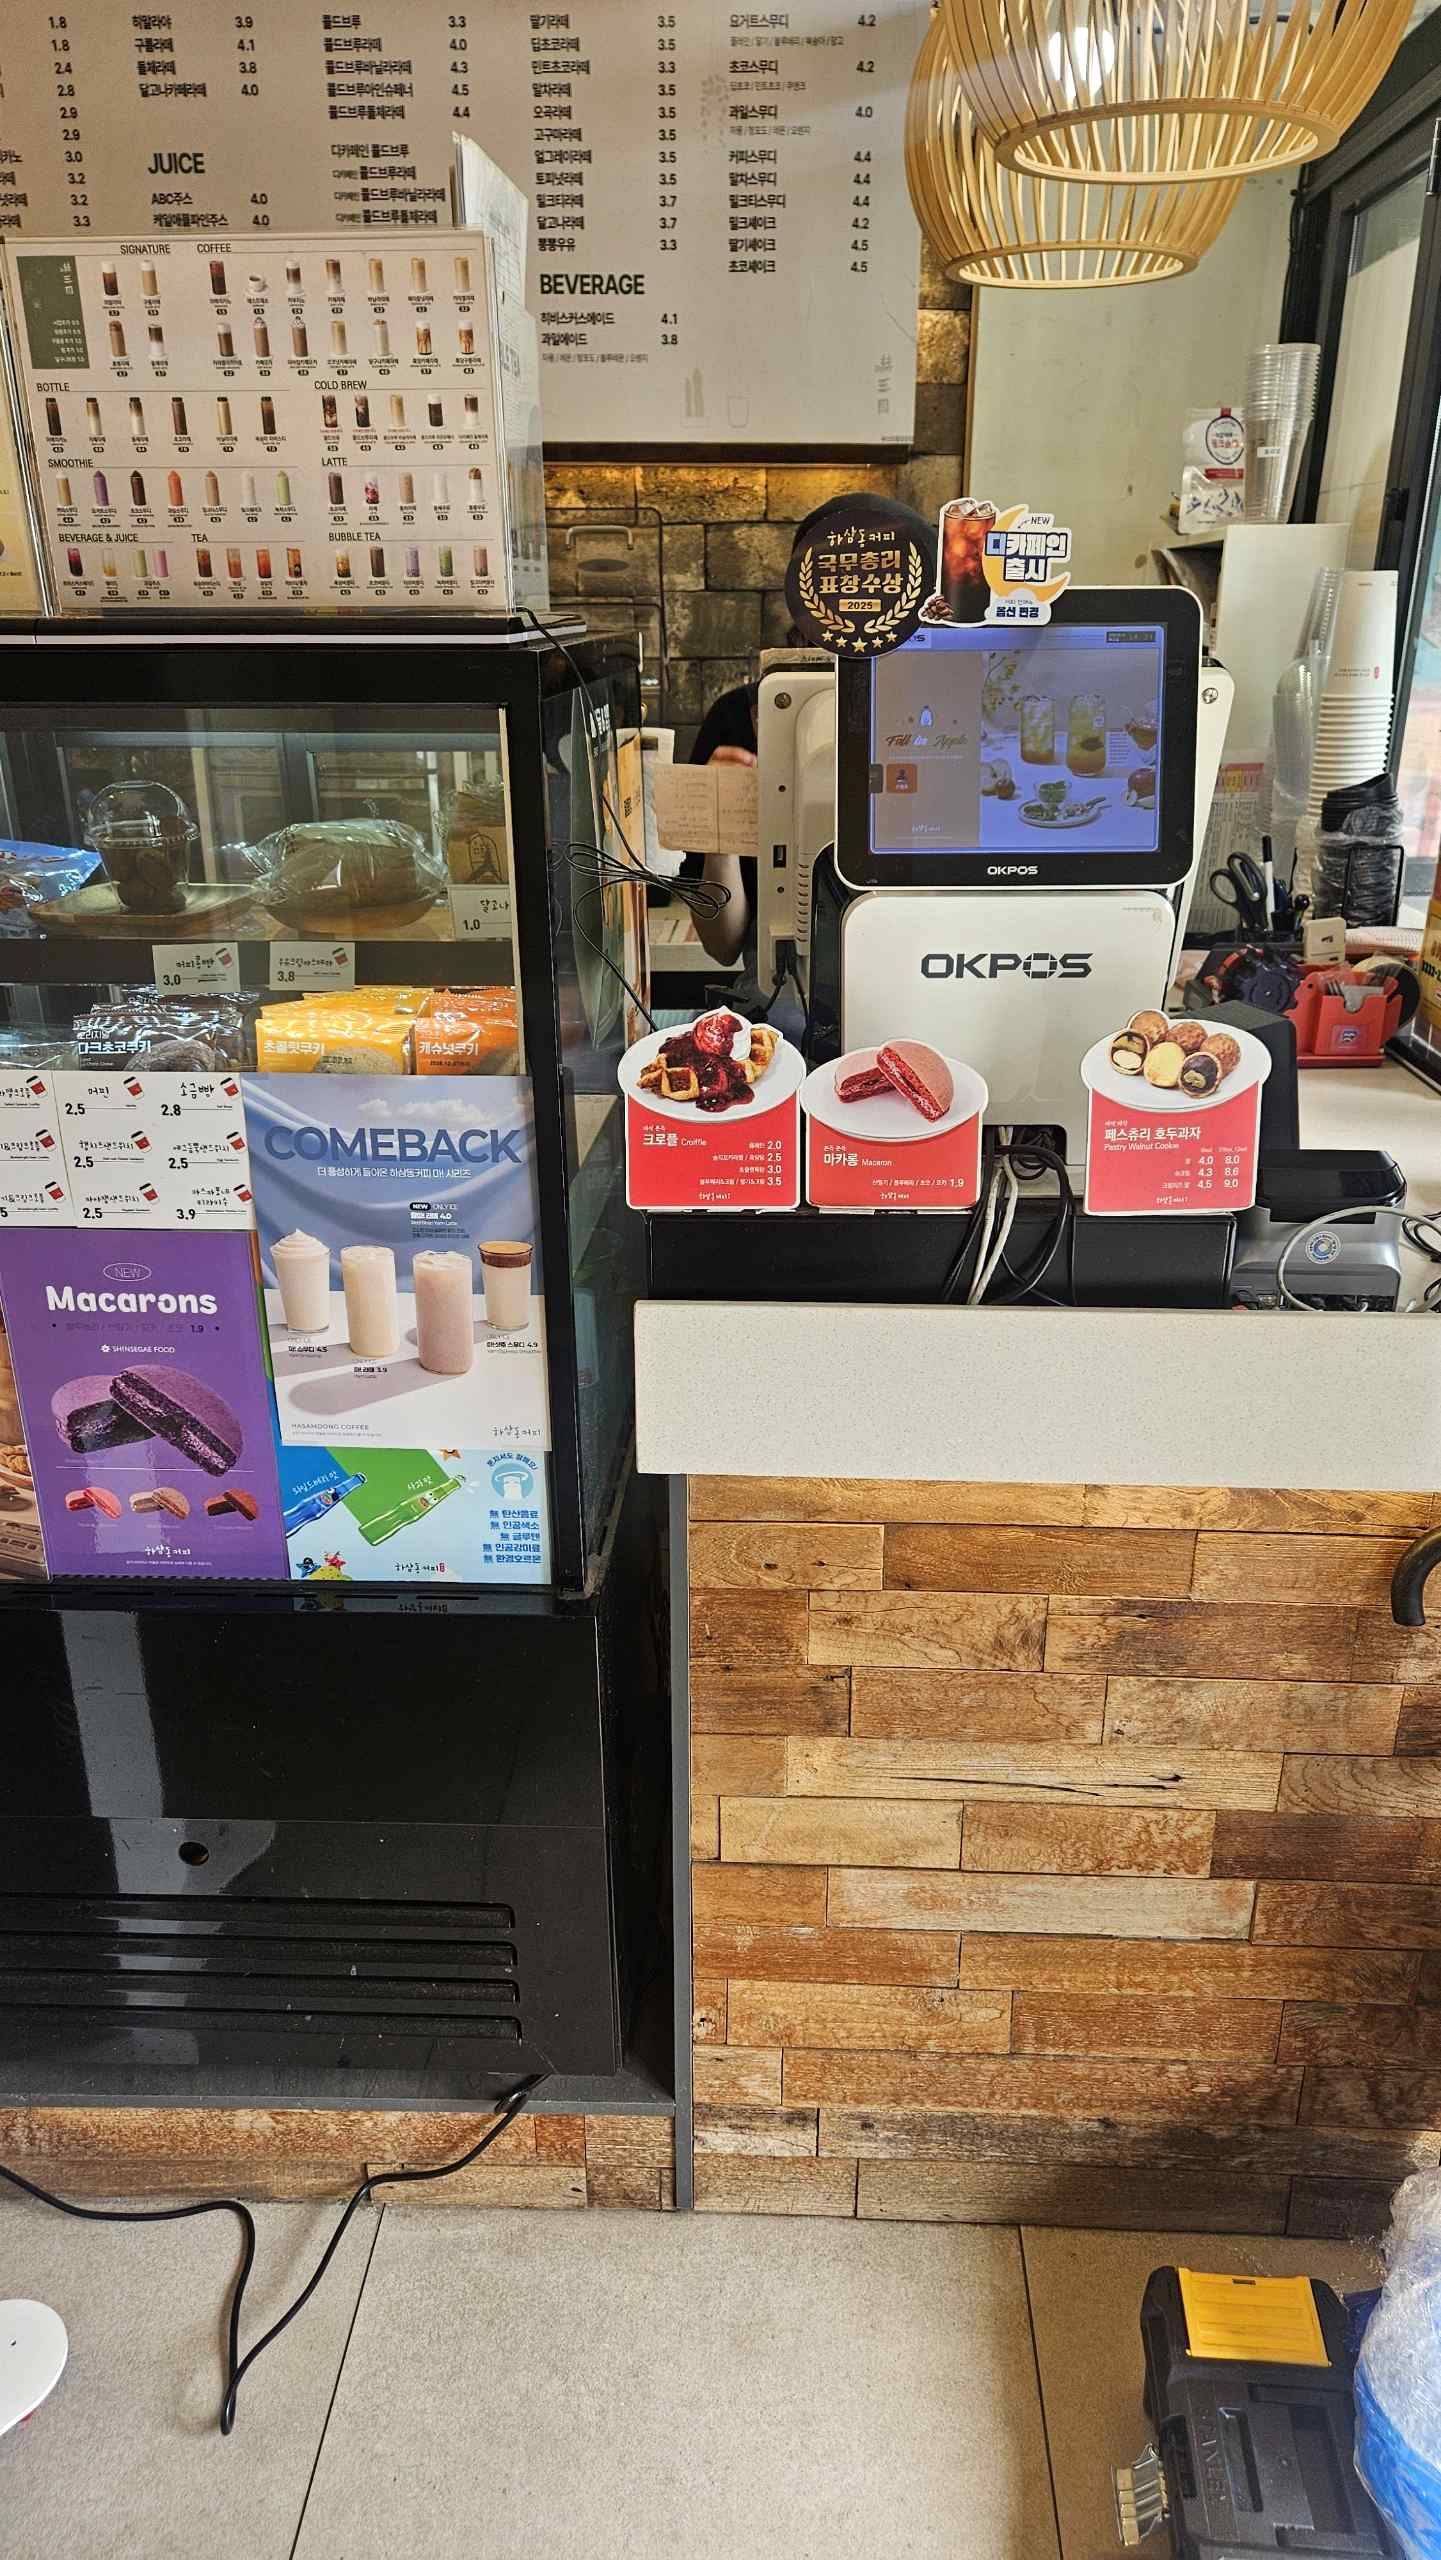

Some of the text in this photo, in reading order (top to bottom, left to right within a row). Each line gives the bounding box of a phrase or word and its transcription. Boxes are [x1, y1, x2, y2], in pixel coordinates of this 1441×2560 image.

[49, 17, 67, 29] 1.8
[235, 16, 253, 29] 3.9
[322, 15, 467, 30] 콜드브루 3.3
[530, 14, 676, 30] 딸기라떼 3.5
[729, 14, 877, 29] 요거트스무디 4.2
[52, 39, 70, 52] 1.8
[237, 39, 255, 52] 4.1
[324, 37, 467, 53] 콜드브루라떼 4.0
[657, 38, 676, 51] 3.5
[55, 62, 72, 74] 2.4
[239, 62, 257, 74] 3.8
[450, 61, 468, 74] 4.3
[532, 60, 676, 75] 민트초코라떼 3.3
[729, 60, 875, 75] 초코스무디 4.2
[58, 85, 75, 97] 2.8
[241, 84, 259, 97] 4.0
[451, 84, 469, 96] 4.5
[658, 84, 676, 96] 3.5
[60, 107, 78, 119] 2.9
[452, 107, 470, 119] 4.4
[658, 107, 676, 119] 3.5
[729, 105, 873, 120] 과일스무디 4.0
[63, 129, 80, 141] 2.9
[534, 128, 677, 142] 고구마라떼 3.5
[372, 143, 409, 158] 콜드브루
[65, 151, 82, 163] 3.0
[659, 151, 677, 164] 3.5
[728, 150, 872, 165] 커피스무디 4.4
[148, 152, 205, 175] JUICE
[68, 172, 85, 185] 3.2
[659, 173, 677, 185] 3.5
[852, 173, 871, 185] 4.4
[71, 194, 88, 206] 3.2
[152, 193, 268, 206] ABC주스 4.0
[659, 195, 677, 207] 3.7
[852, 195, 870, 207] 4.4
[73, 215, 90, 227] 3.3
[252, 215, 270, 227] 4.0
[659, 218, 677, 230] 3.7
[851, 217, 870, 230] 4.2
[120, 244, 171, 256] SIGNATURE
[197, 243, 232, 254] COFFEE
[659, 239, 677, 251] 3.3
[850, 239, 869, 252] 4.5
[850, 261, 869, 273] 4.5
[540, 274, 645, 295] BEVERAGE
[661, 313, 678, 325] 4.1
[541, 333, 678, 347] 과일에이드 3.8
[36, 382, 70, 393] BOTTLE
[314, 380, 367, 391] COLD BREW
[48, 458, 94, 469] SMOOTHIE
[321, 457, 348, 467] LATTE
[1031, 516, 1051, 525] NEW
[58, 533, 139, 543] BEVERAGE & JUICE
[192, 533, 209, 543] TEA
[328, 532, 381, 542] BUBBLE TEA
[985, 531, 1068, 557] 디카페인
[817, 550, 903, 572] 국무총리
[1004, 556, 1048, 582] 출시
[819, 573, 904, 595] 표창수상
[847, 601, 873, 610] 2025
[1019, 606, 1040, 618] 변경
[987, 865, 1039, 876] OKPOS
[480, 898, 511, 912] 달고나
[463, 919, 481, 930] 1.0
[920, 952, 1095, 979] OKPOS
[163, 975, 181, 986] 3.0
[277, 971, 295, 982] 3.8
[418, 1041, 479, 1057] 캐슈넛쿠키
[88, 1086, 109, 1099] 머핀
[180, 1082, 215, 1099] 소금빵
[65, 1103, 85, 1116] 2.5
[161, 1104, 181, 1117] 2.8
[1153, 1126, 1201, 1141] 호두과자
[264, 1126, 523, 1165] COMEBACK
[643, 1133, 679, 1147] 크로플
[767, 1140, 782, 1150] 2.0
[1103, 1141, 1180, 1152] Pastry Walnut Cookie
[74, 1156, 94, 1168] 2.5
[168, 1157, 188, 1169] 2.5
[767, 1152, 782, 1162] 2.5
[824, 1152, 893, 1167] 마카롱 Macaron
[1198, 1155, 1240, 1165] 4.0 8.0
[767, 1165, 782, 1174] 3.0
[1197, 1168, 1214, 1178] 4.3
[767, 1177, 782, 1186] 3.5
[949, 1178, 965, 1188] 1.9
[83, 1207, 102, 1219] 2.5
[176, 1208, 195, 1220] 3.9
[114, 1266, 142, 1279] NEW
[45, 1285, 218, 1315] Macarons
[190, 1324, 204, 1333] 1.9
[112, 1345, 175, 1354] SHINSEGAE FOOD
[340, 1423, 369, 1431] COFFEE
[407, 1480, 422, 1490] 사과
[502, 1509, 539, 1519] 탄산음료
[503, 1520, 540, 1530] 인공색소
[495, 1543, 541, 1553] 인공감미료
[496, 1554, 542, 1564] 환경호르몬
